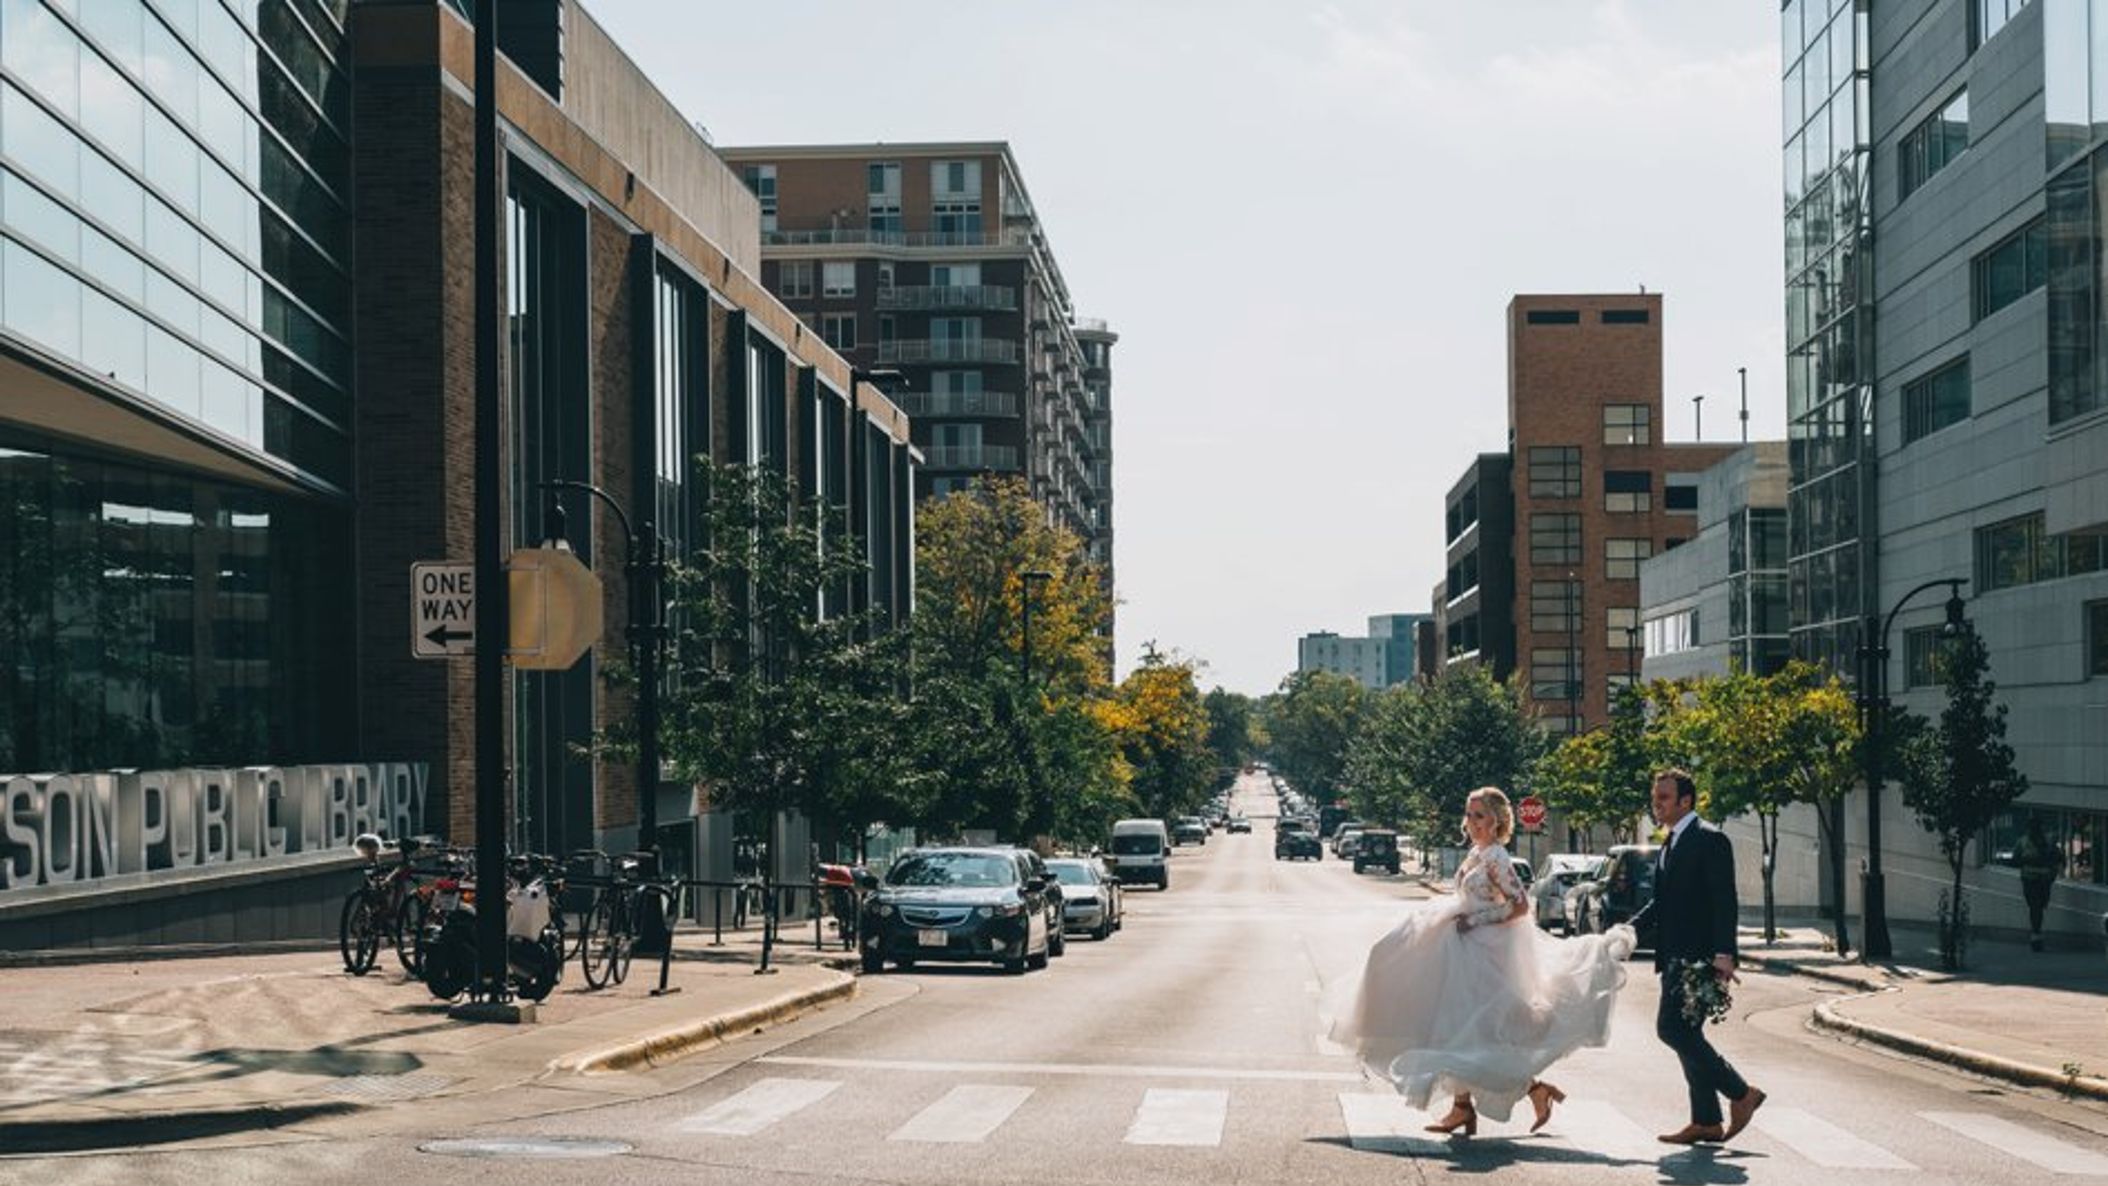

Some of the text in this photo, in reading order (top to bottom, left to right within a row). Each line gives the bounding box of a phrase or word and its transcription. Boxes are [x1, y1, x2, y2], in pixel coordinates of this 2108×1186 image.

[423, 572, 472, 595] ONE
[421, 599, 472, 621] WAY
[1518, 805, 1545, 818] STOP
[6, 763, 430, 890] SON PUBLIC LIBRARY
